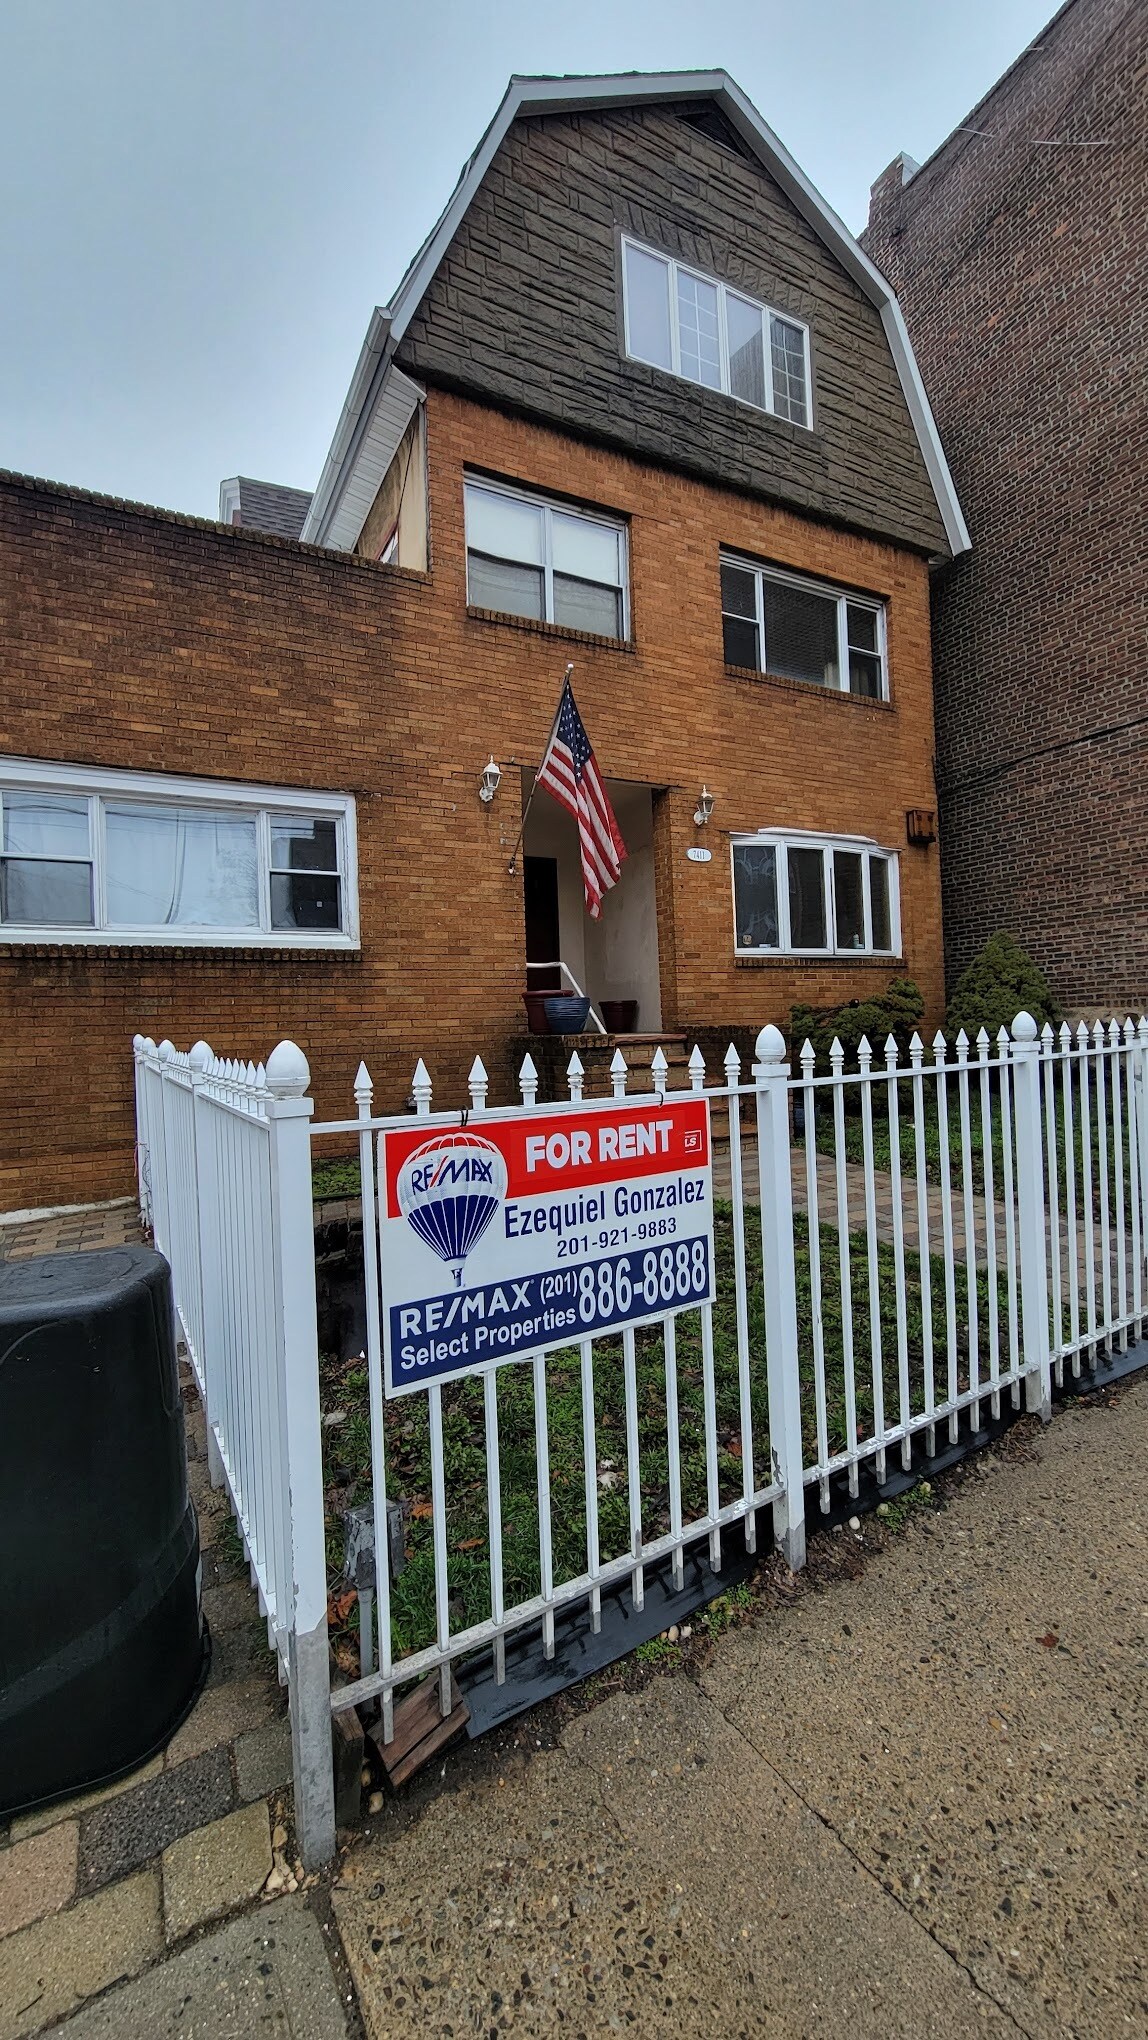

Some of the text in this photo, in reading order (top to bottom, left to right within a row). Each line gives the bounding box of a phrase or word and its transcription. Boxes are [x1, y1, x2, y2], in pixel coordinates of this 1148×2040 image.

[526, 1119, 674, 1173] FOR RENT
[411, 1155, 493, 1196] RE/MAX
[504, 1177, 705, 1239] Ezequiel Gonzalez
[557, 1217, 677, 1258] 201-921-9883
[400, 1240, 706, 1340] RE/MAX (201) 886-8888
[400, 1307, 577, 1370] Select Properties
